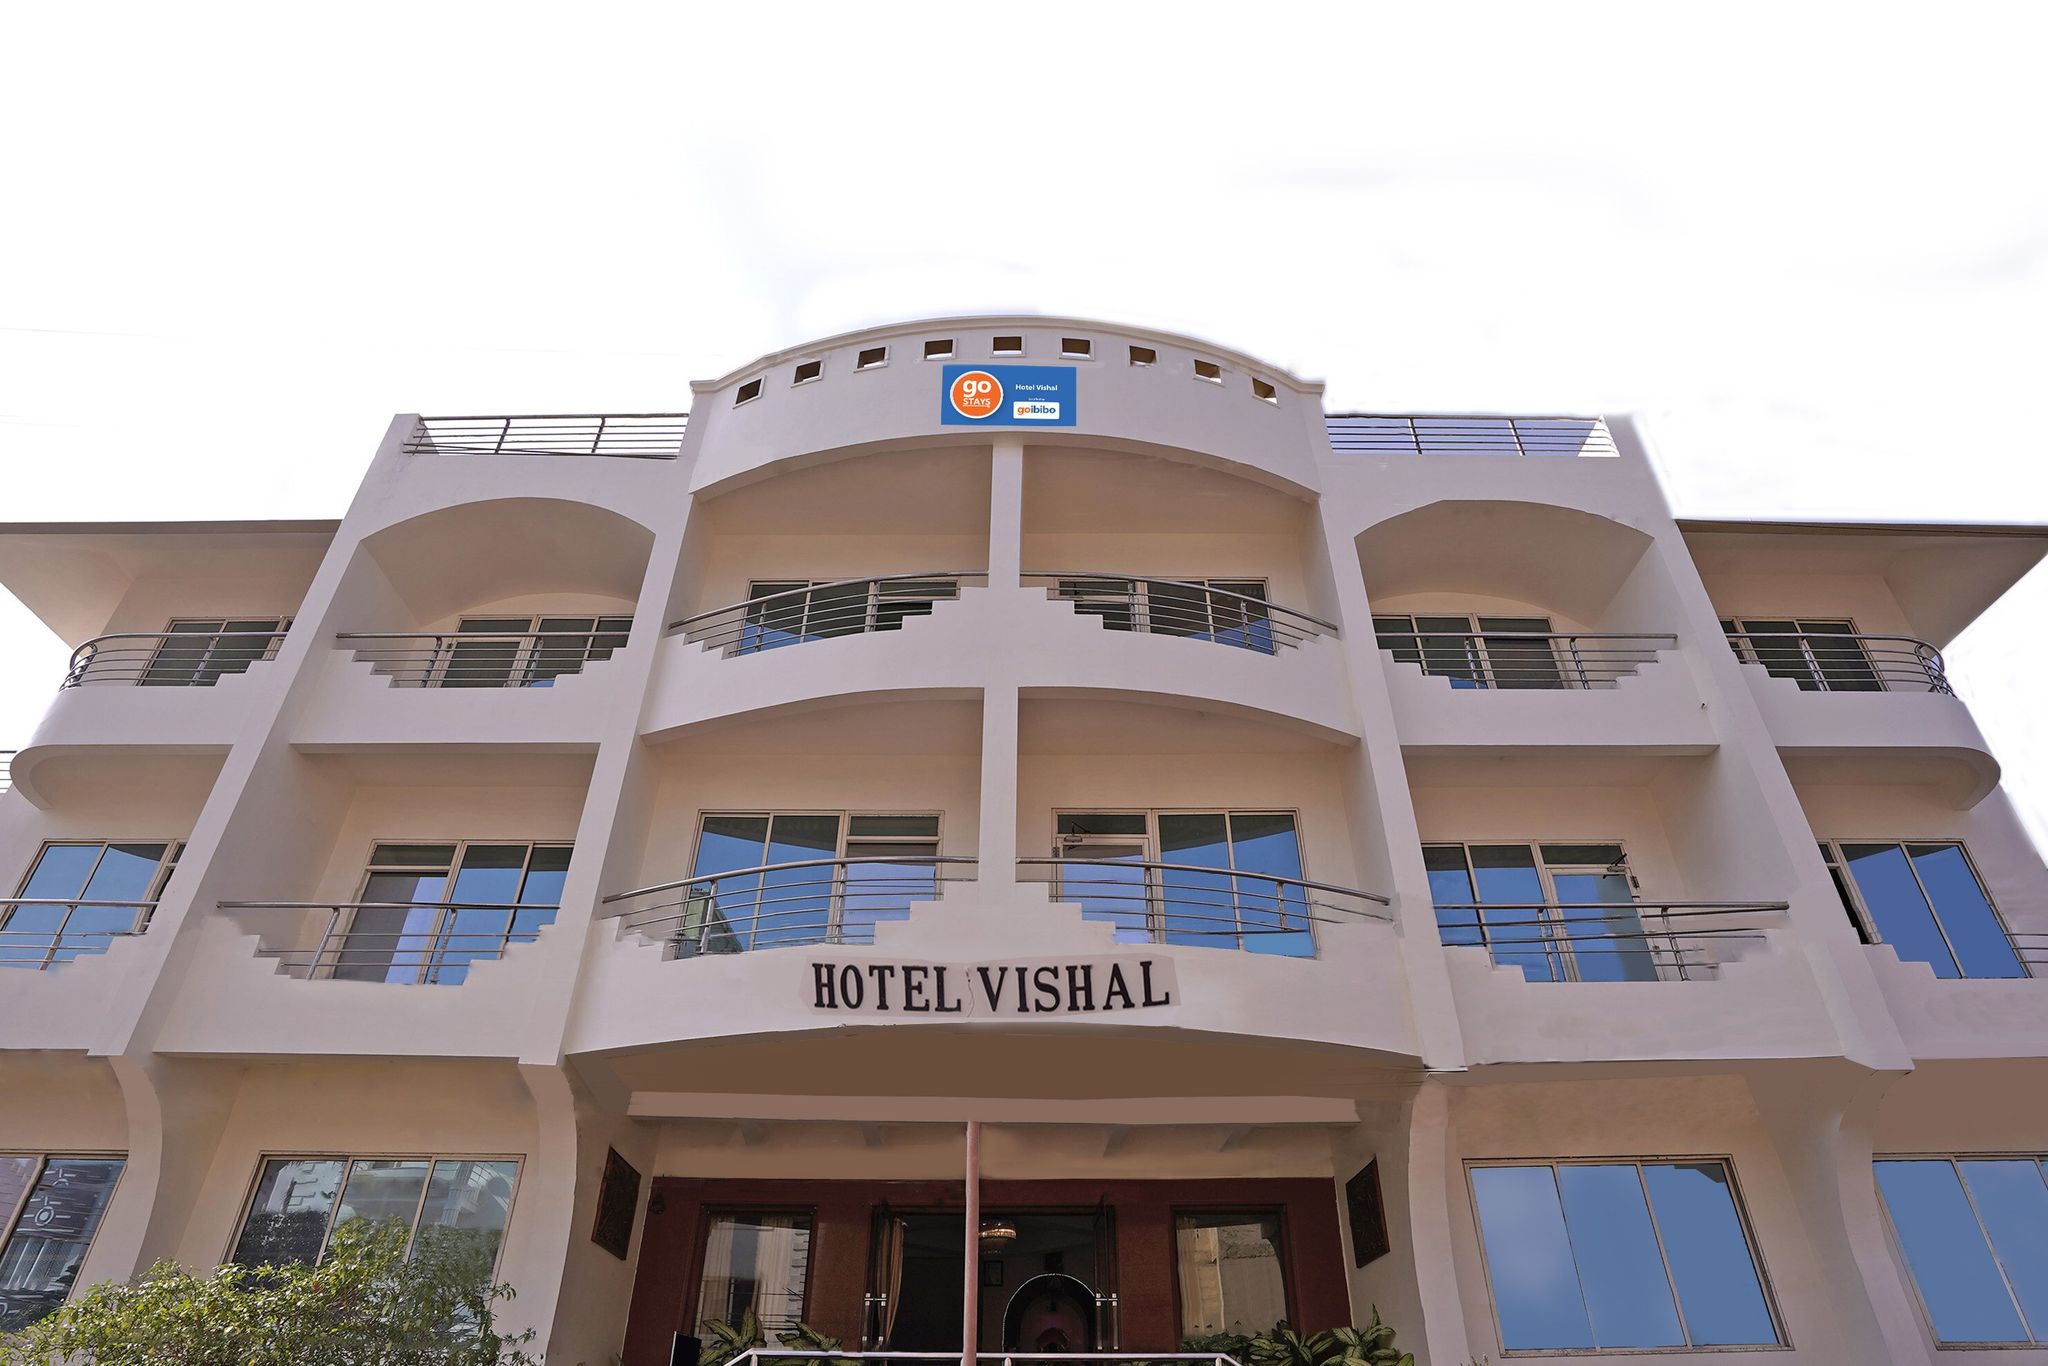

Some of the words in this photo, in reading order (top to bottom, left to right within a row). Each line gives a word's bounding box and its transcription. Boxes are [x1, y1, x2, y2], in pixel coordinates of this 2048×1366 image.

[963, 380, 992, 398] go
[963, 398, 991, 406] STAYS
[1017, 405, 1056, 415] goibibo
[812, 963, 962, 1012] HOTEL
[977, 961, 1170, 1012] VISHAL
